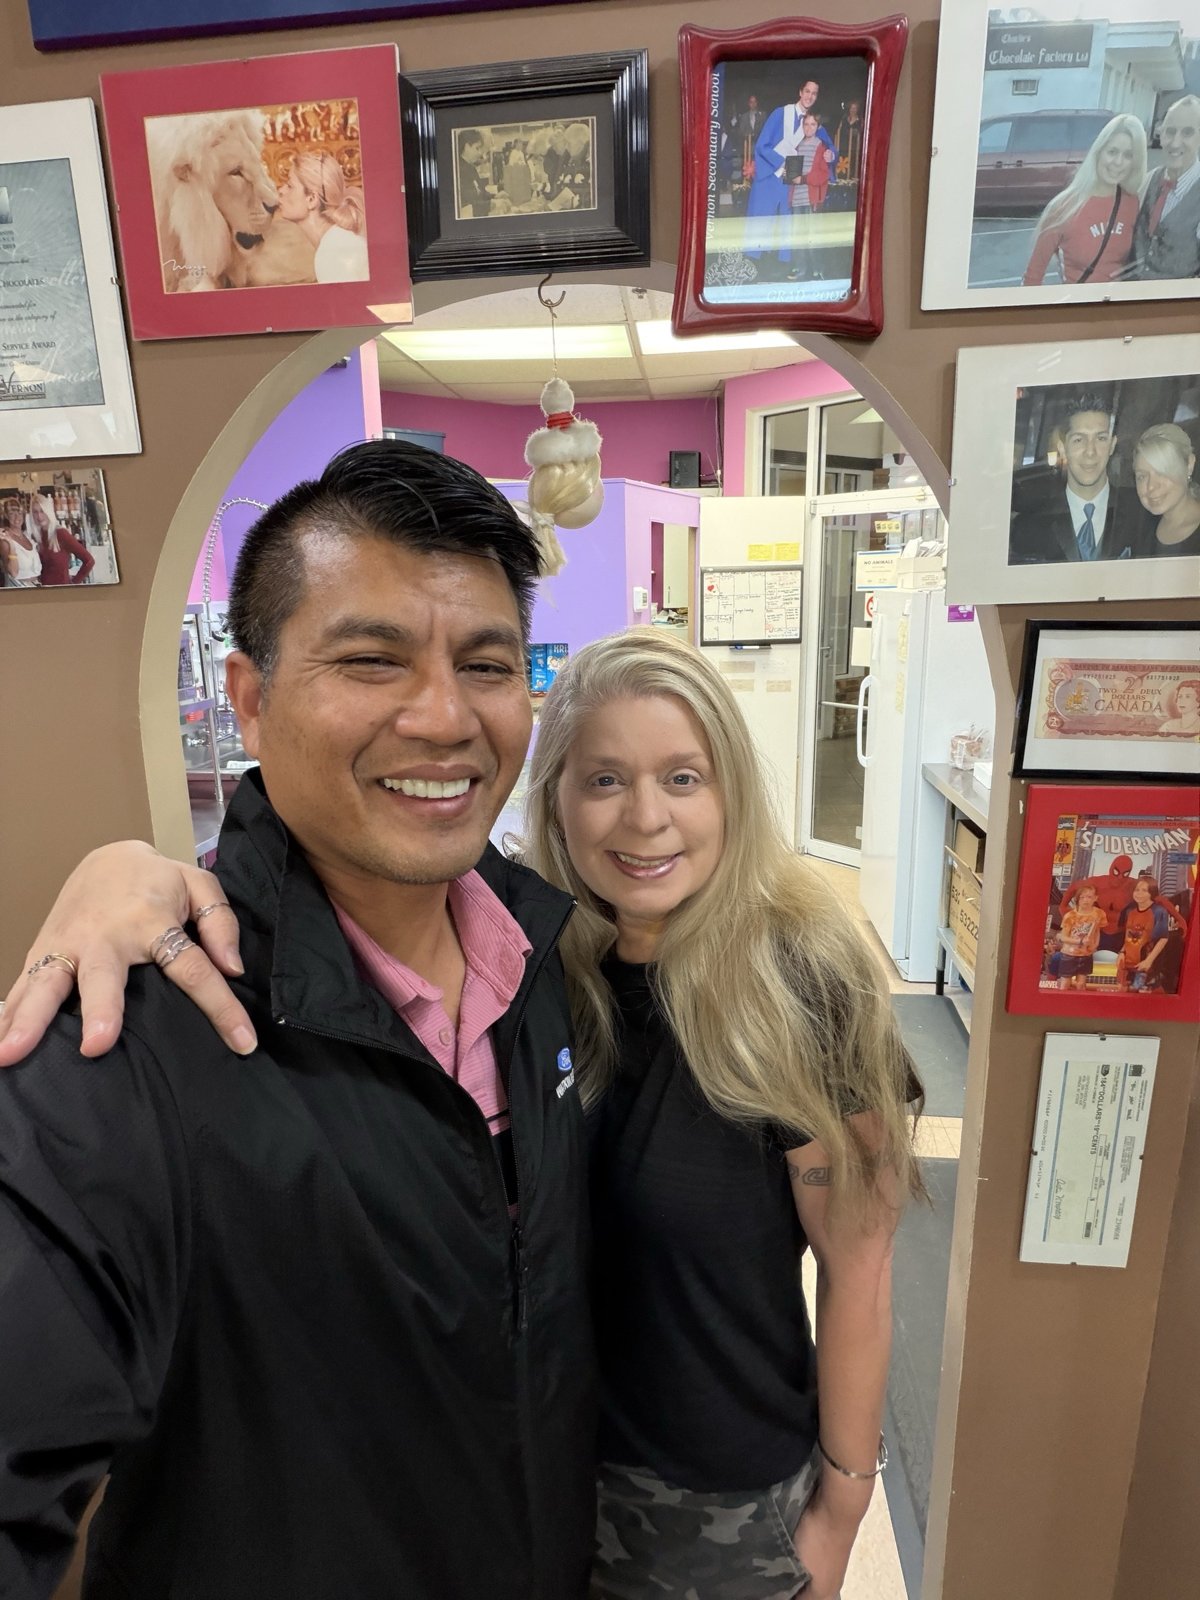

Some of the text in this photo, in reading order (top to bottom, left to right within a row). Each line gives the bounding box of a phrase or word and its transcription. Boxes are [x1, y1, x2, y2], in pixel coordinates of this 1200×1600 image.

[988, 48, 1036, 65] Chocolate
[1037, 47, 1074, 64] Factory
[1089, 222, 1124, 238] NIE
[1094, 699, 1163, 712] CANADA
